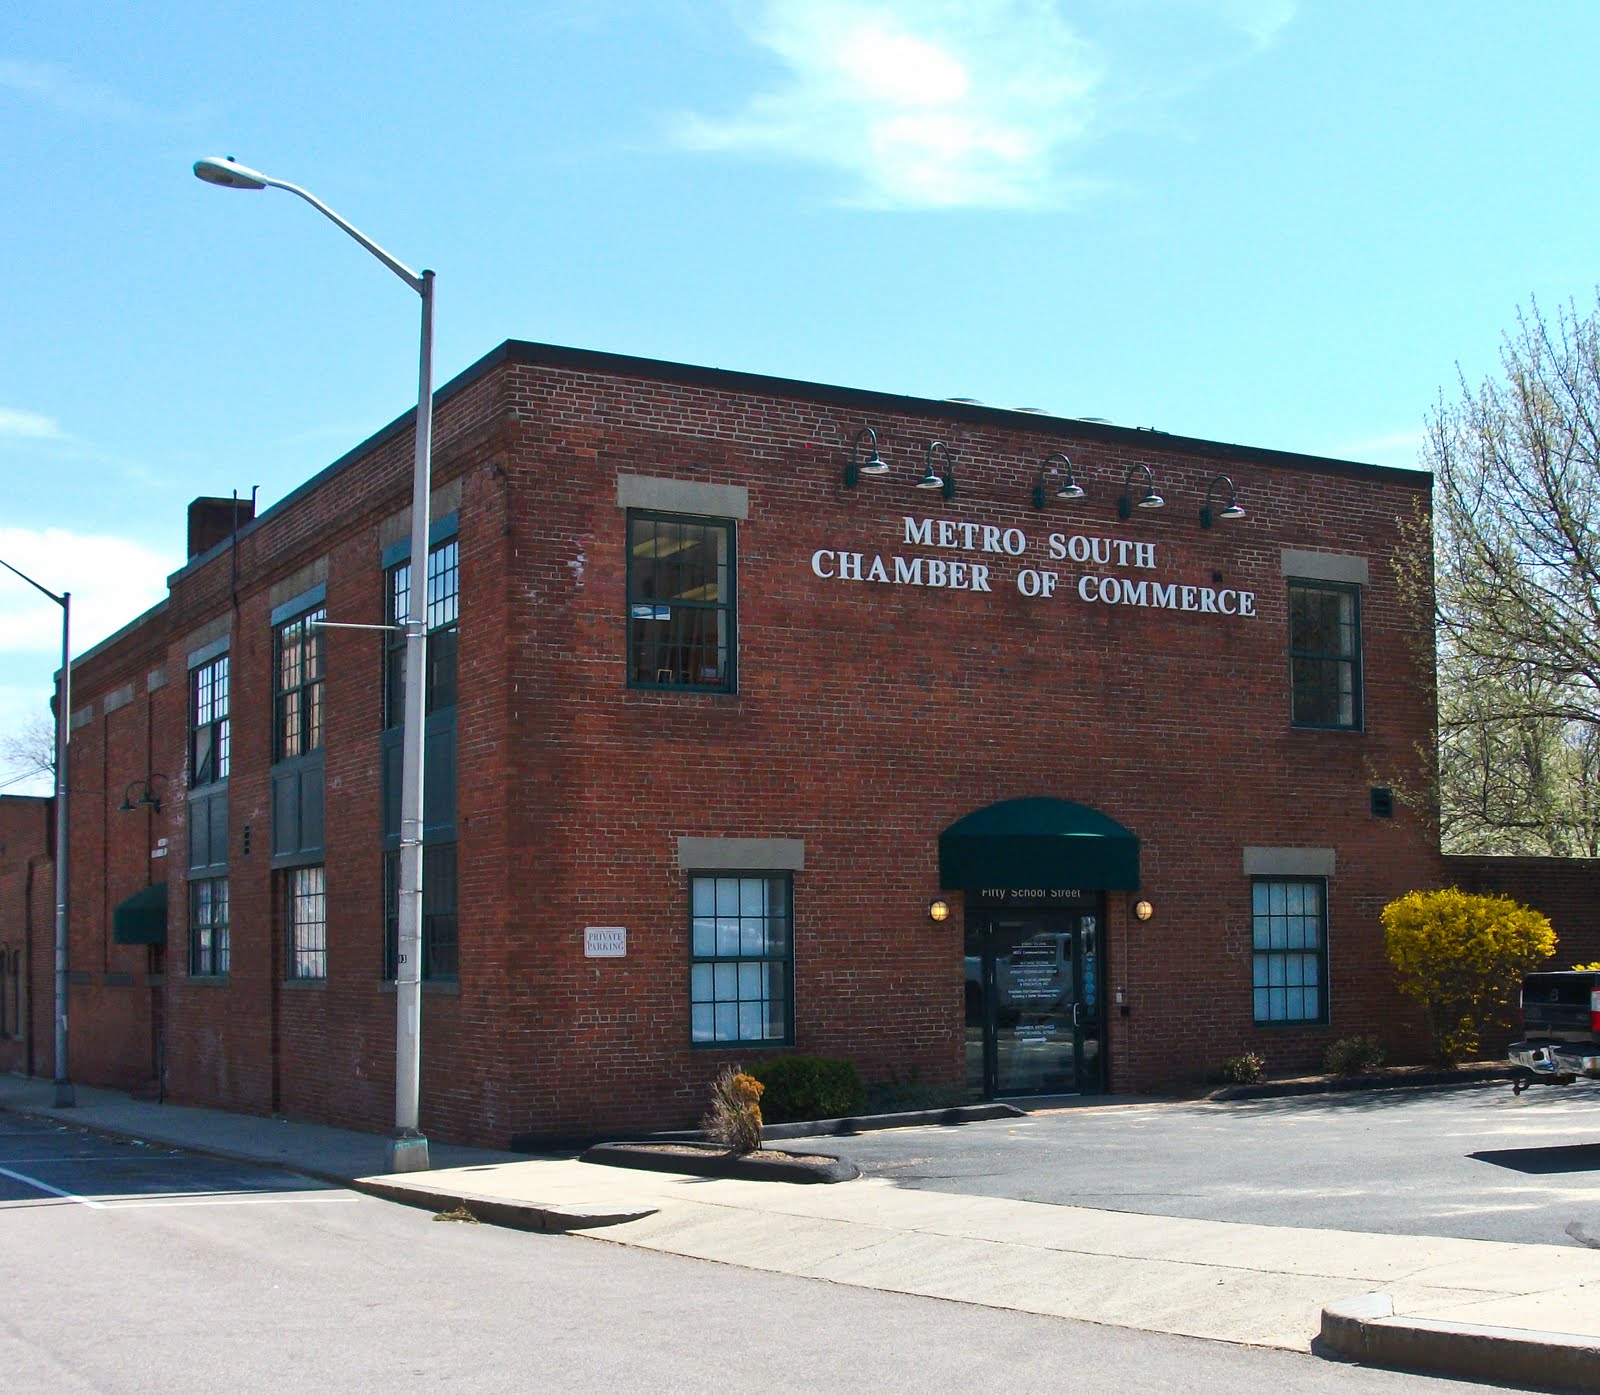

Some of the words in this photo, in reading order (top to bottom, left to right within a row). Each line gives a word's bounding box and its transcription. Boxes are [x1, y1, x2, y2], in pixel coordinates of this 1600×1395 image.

[902, 516, 1026, 556] METRO
[1049, 533, 1157, 569] SOUTH
[811, 549, 992, 593] CHAMBER
[1017, 569, 1058, 598] OF
[1078, 575, 1257, 617] COMMERCE
[1011, 888, 1046, 898] School
[1051, 888, 1081, 898] Street
[589, 932, 622, 941] PRIVATE
[587, 941, 624, 951] PARKING
